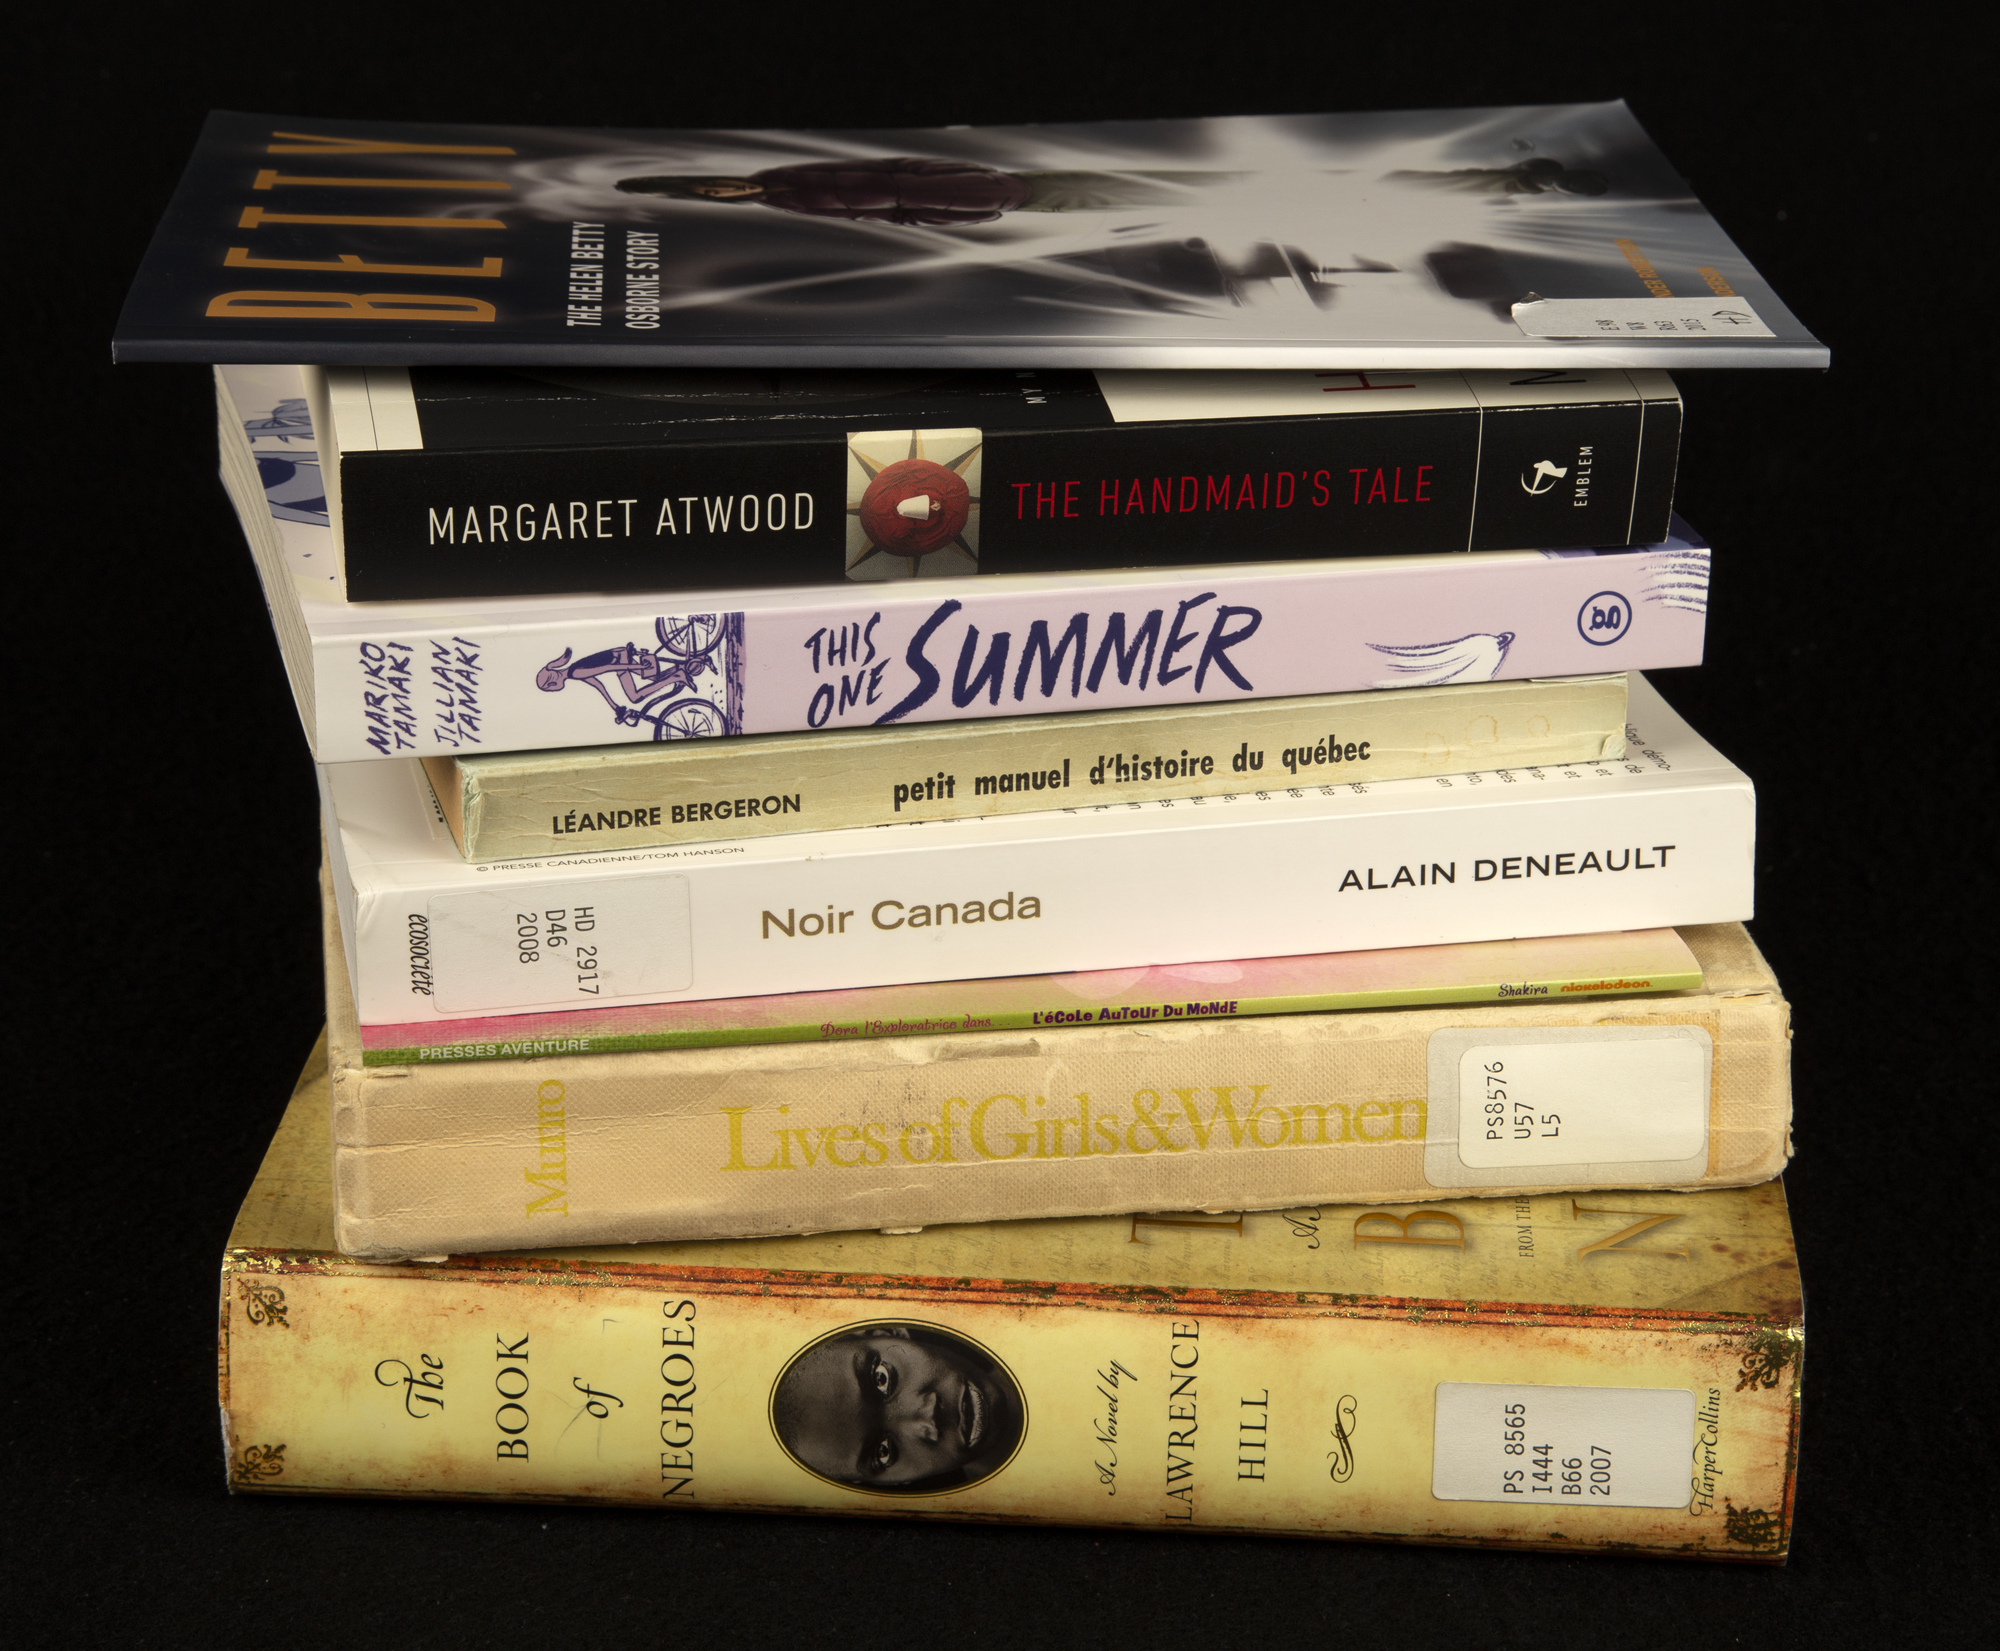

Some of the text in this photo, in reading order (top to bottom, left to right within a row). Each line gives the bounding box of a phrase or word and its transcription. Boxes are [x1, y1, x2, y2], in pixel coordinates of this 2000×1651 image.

[205, 131, 517, 322] BETTY
[566, 221, 605, 327] THE HELEN BETTY
[625, 230, 660, 330] OSBORNE STORY
[1613, 239, 1659, 279] ROBERTSON
[1011, 465, 1434, 520] THE HANDMAID'S TALE
[1574, 446, 1594, 507] EMBLEM
[429, 492, 815, 545] MARGARET ATWOOD
[804, 611, 881, 673] THIS
[870, 592, 1262, 726] SUMMER
[359, 641, 393, 755] MARIKO
[386, 641, 418, 750] TAMAKI
[428, 638, 460, 748] JILLIAN
[451, 636, 484, 744] TAMAKI
[806, 657, 892, 728] ONE
[893, 734, 1371, 811] petit manuel d'histoire du québec
[553, 793, 801, 834] LÉANDRE BERGERON
[492, 862, 543, 871] PRESSE
[683, 847, 745, 857] HANSON
[1338, 845, 1676, 892] ALAIN DENEAULT
[517, 913, 540, 964] 2008
[545, 909, 568, 948] D46
[762, 891, 1042, 939] Noir Canada
[574, 906, 600, 995] HD 2917
[1163, 1004, 1183, 1017] Du
[1498, 979, 1650, 997] Shakira nickelodeon
[419, 1039, 589, 1060] PRESSES AVENTURE
[820, 1020, 859, 1039] Dora
[864, 1018, 957, 1036] l'Exploratrice
[1484, 1061, 1507, 1140] PS8576
[1514, 1102, 1534, 1140] U57
[1541, 1113, 1561, 1138] L5
[524, 1079, 569, 1219] Munro
[719, 1104, 889, 1173] Lives
[899, 1096, 968, 1165] of
[1514, 1198, 1534, 1259] FROM THE
[374, 1352, 445, 1419] The
[495, 1332, 530, 1463] BOOK
[573, 1376, 625, 1419] of
[660, 1300, 697, 1500] NEGROES
[1093, 1359, 1138, 1496] A Novel by
[1165, 1319, 1200, 1522] LAWRENCE
[1237, 1388, 1269, 1482] HILL
[1503, 1403, 1526, 1494] PS 8565
[1689, 1388, 1723, 1517] HarperCollins
[1532, 1444, 1554, 1494] I444
[1562, 1457, 1582, 1495] B66
[1590, 1445, 1612, 1496] 2007
